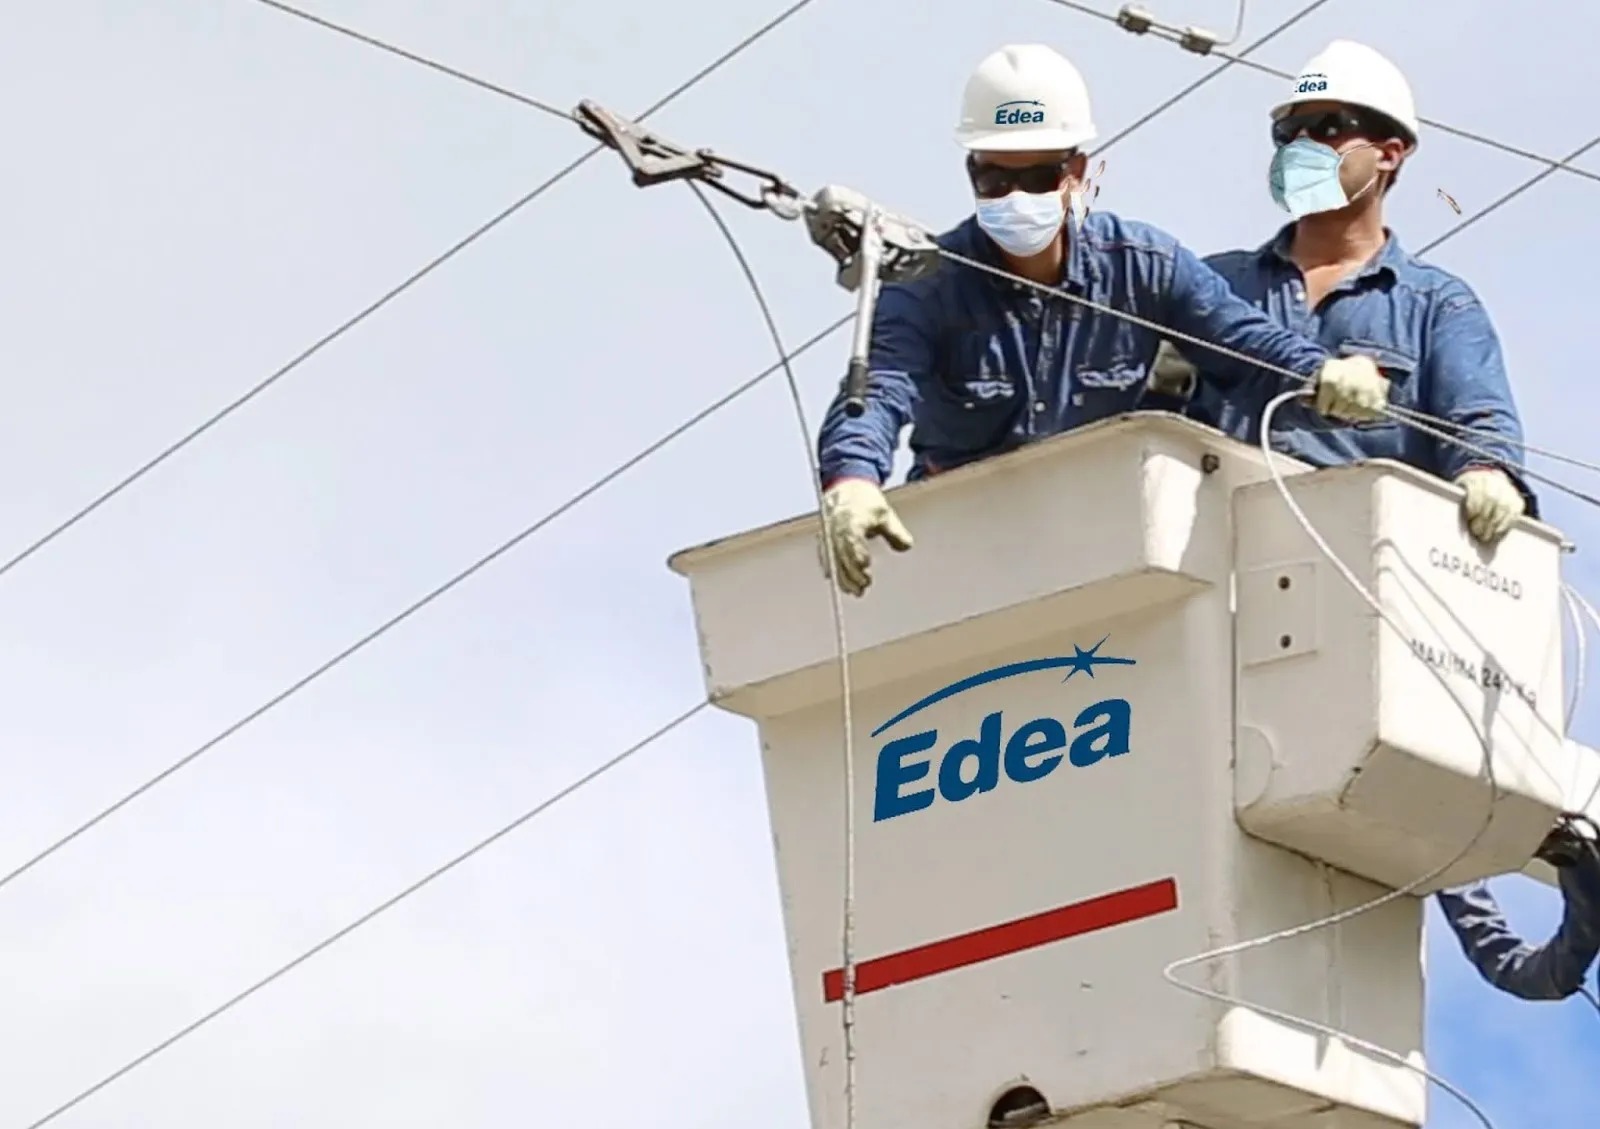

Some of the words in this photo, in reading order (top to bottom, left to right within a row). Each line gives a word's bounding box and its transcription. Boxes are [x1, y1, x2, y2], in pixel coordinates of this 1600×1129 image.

[1294, 79, 1328, 93] dea
[994, 109, 1045, 125] Edea
[1429, 546, 1522, 600] CAPACIDAD
[1481, 667, 1512, 694] 240
[873, 698, 1131, 823] Edea
